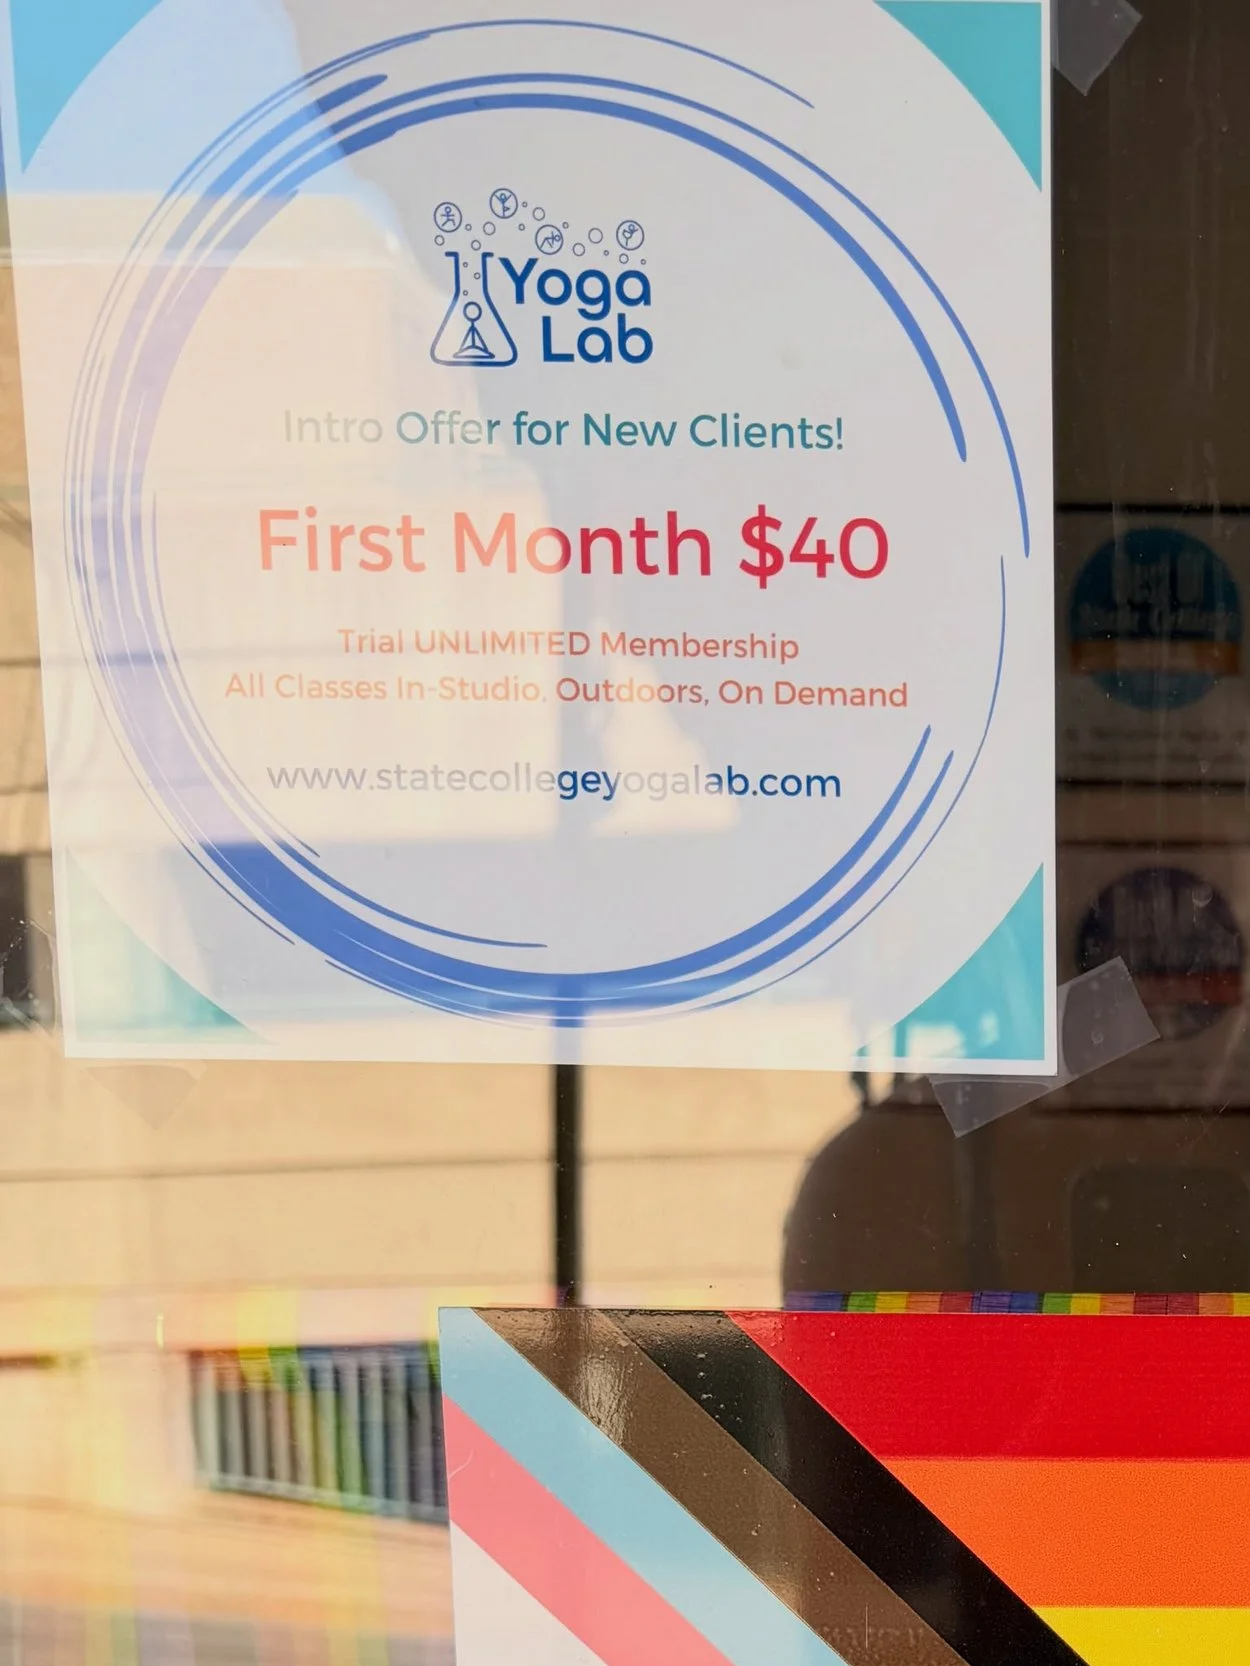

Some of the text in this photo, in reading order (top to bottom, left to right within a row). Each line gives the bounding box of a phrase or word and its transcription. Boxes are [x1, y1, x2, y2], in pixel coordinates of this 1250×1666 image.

[498, 256, 651, 321] Yoga
[541, 312, 654, 364] Lab
[283, 410, 845, 451] Intro Offer for New Clients!
[258, 503, 889, 588] First Month $40
[338, 627, 799, 663] Trial UNLIMITED Membership
[224, 672, 908, 709] All Classes In-Studio, Outdoors, On Demand
[266, 762, 841, 803] www.statecollegeyogalab.com
